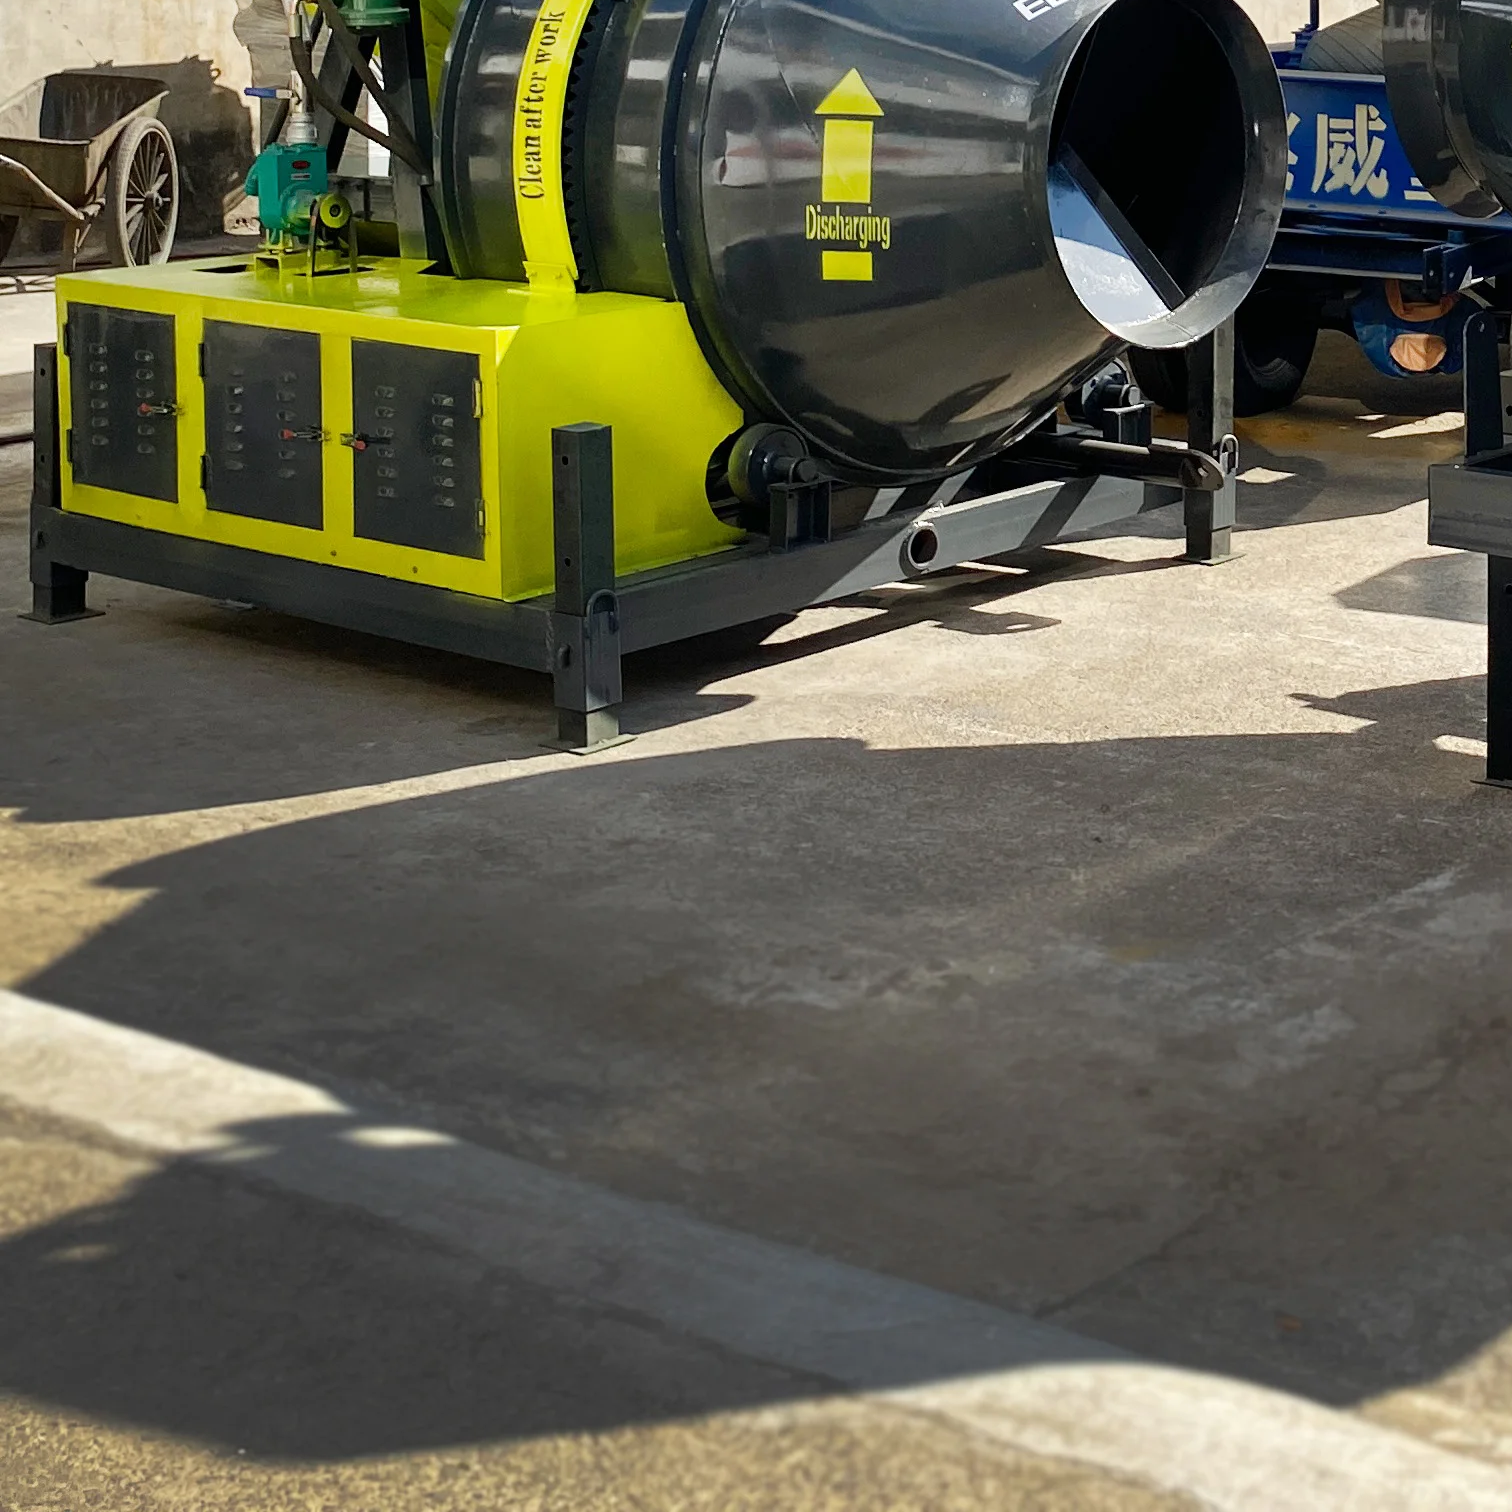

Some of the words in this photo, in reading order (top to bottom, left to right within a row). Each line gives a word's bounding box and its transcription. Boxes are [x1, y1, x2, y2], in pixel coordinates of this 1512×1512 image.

[534, 11, 566, 65] work
[519, 71, 548, 129] after
[518, 135, 545, 199] Clean
[805, 204, 890, 249] Discharging
